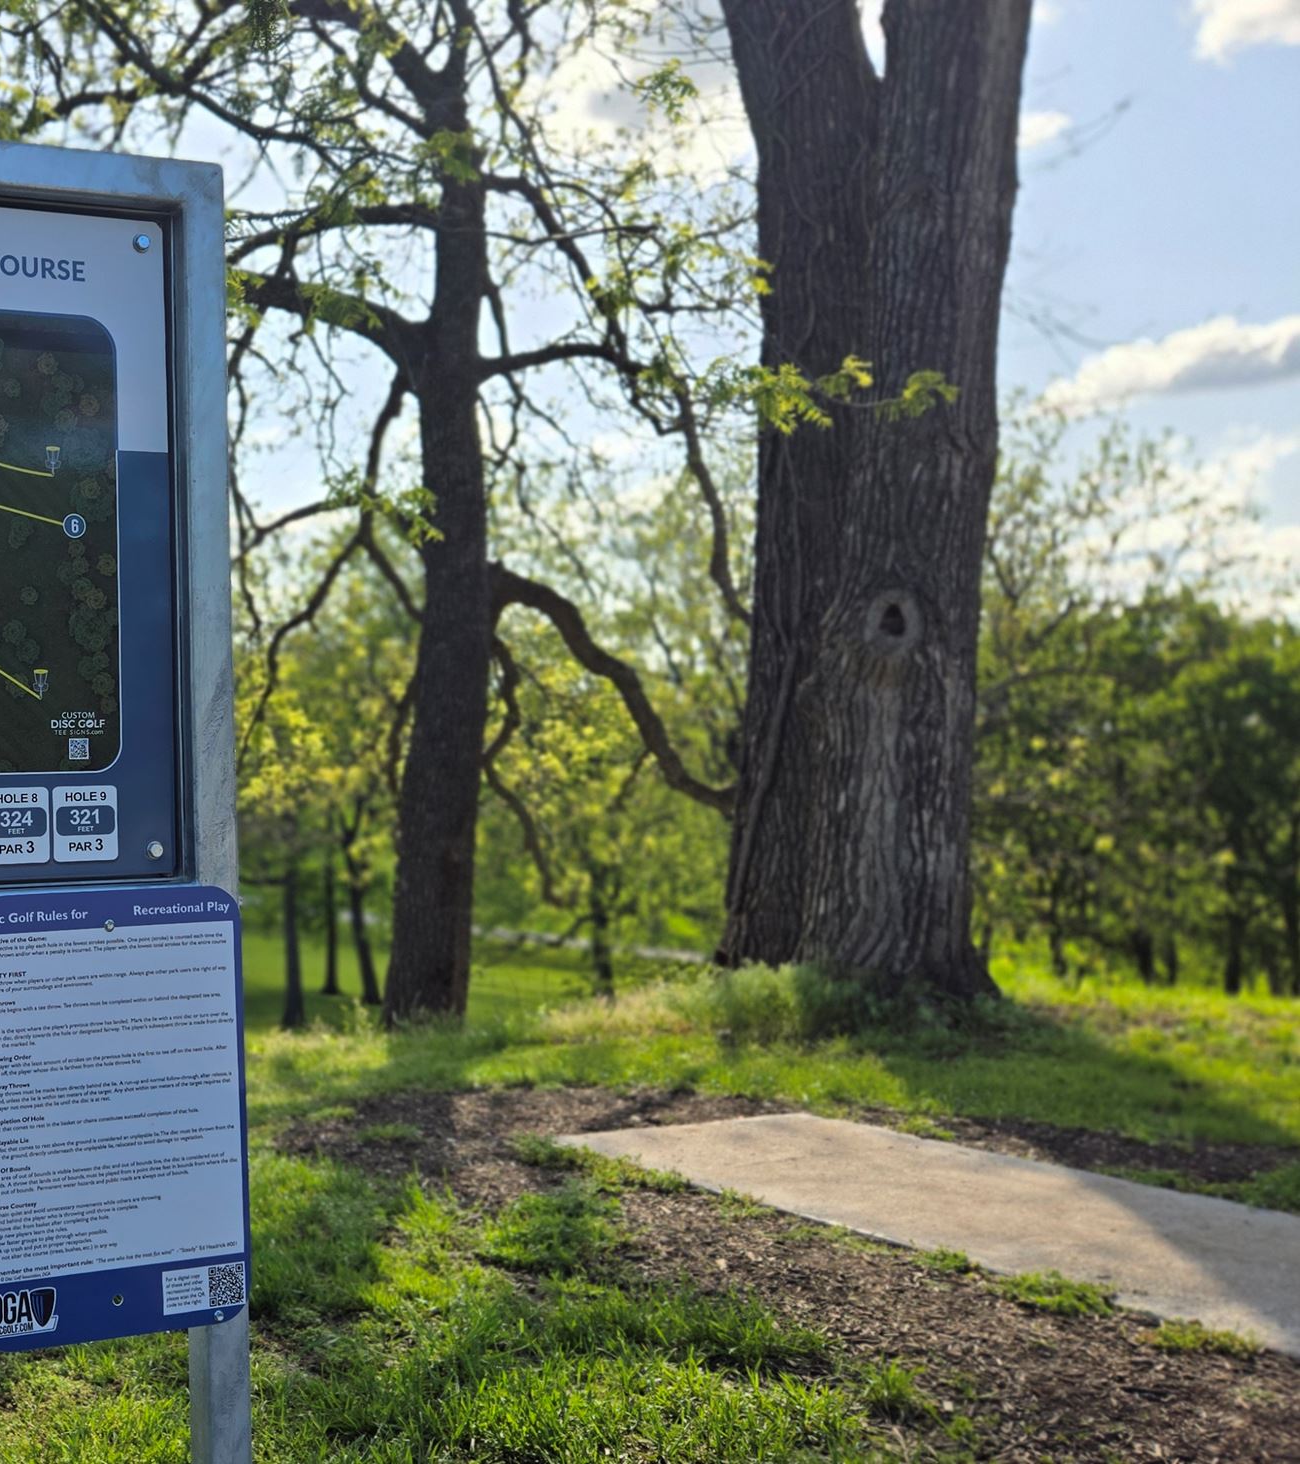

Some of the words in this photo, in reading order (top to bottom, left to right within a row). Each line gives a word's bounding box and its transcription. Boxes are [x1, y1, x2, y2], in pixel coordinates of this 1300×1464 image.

[71, 518, 79, 534] 6
[51, 720, 75, 728] DISC
[78, 720, 105, 728] GOLF
[31, 794, 38, 803] 8
[65, 792, 97, 802] HOLE
[99, 792, 107, 801] 9
[0, 811, 33, 827] 324
[69, 809, 100, 825] 321
[0, 844, 23, 854] PAR
[26, 841, 35, 853] 3
[69, 842, 92, 852] PAR
[95, 839, 103, 851] 3
[8, 912, 34, 923] Golf
[37, 911, 68, 921] Rules
[71, 909, 88, 919] for
[133, 902, 203, 915] Recreational
[207, 901, 229, 913] Play
[50, 1262, 79, 1271] important
